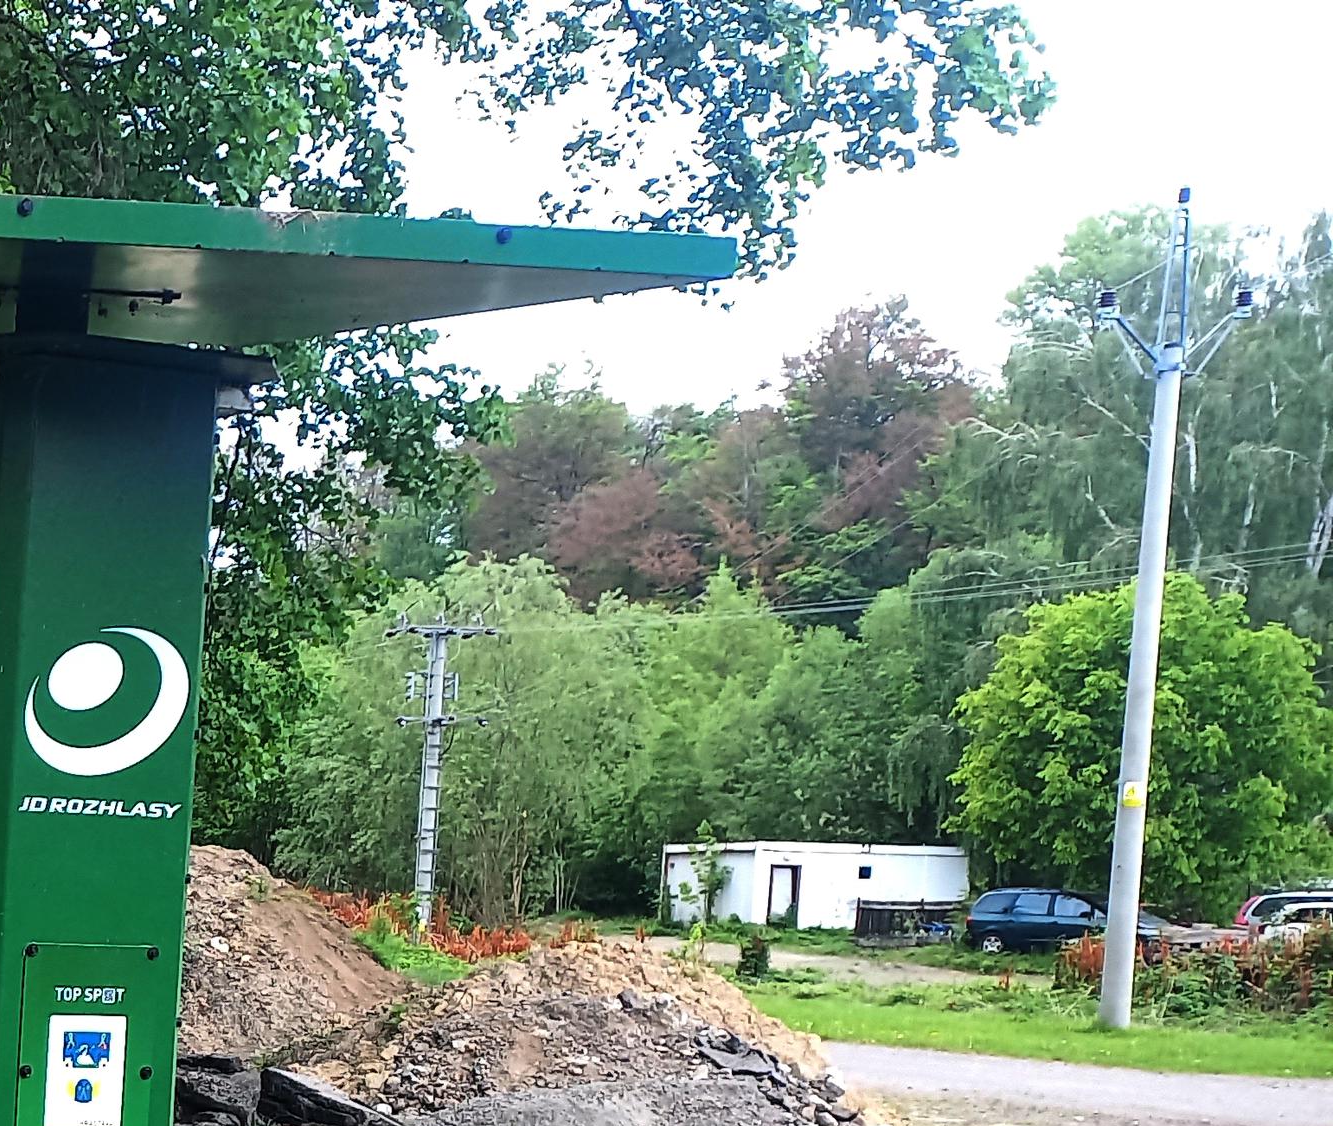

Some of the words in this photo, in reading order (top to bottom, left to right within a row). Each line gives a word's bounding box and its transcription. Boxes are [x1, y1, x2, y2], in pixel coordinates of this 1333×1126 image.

[18, 796, 48, 812] JD
[49, 797, 182, 819] ROZHLASY
[55, 987, 82, 1002] TOP
